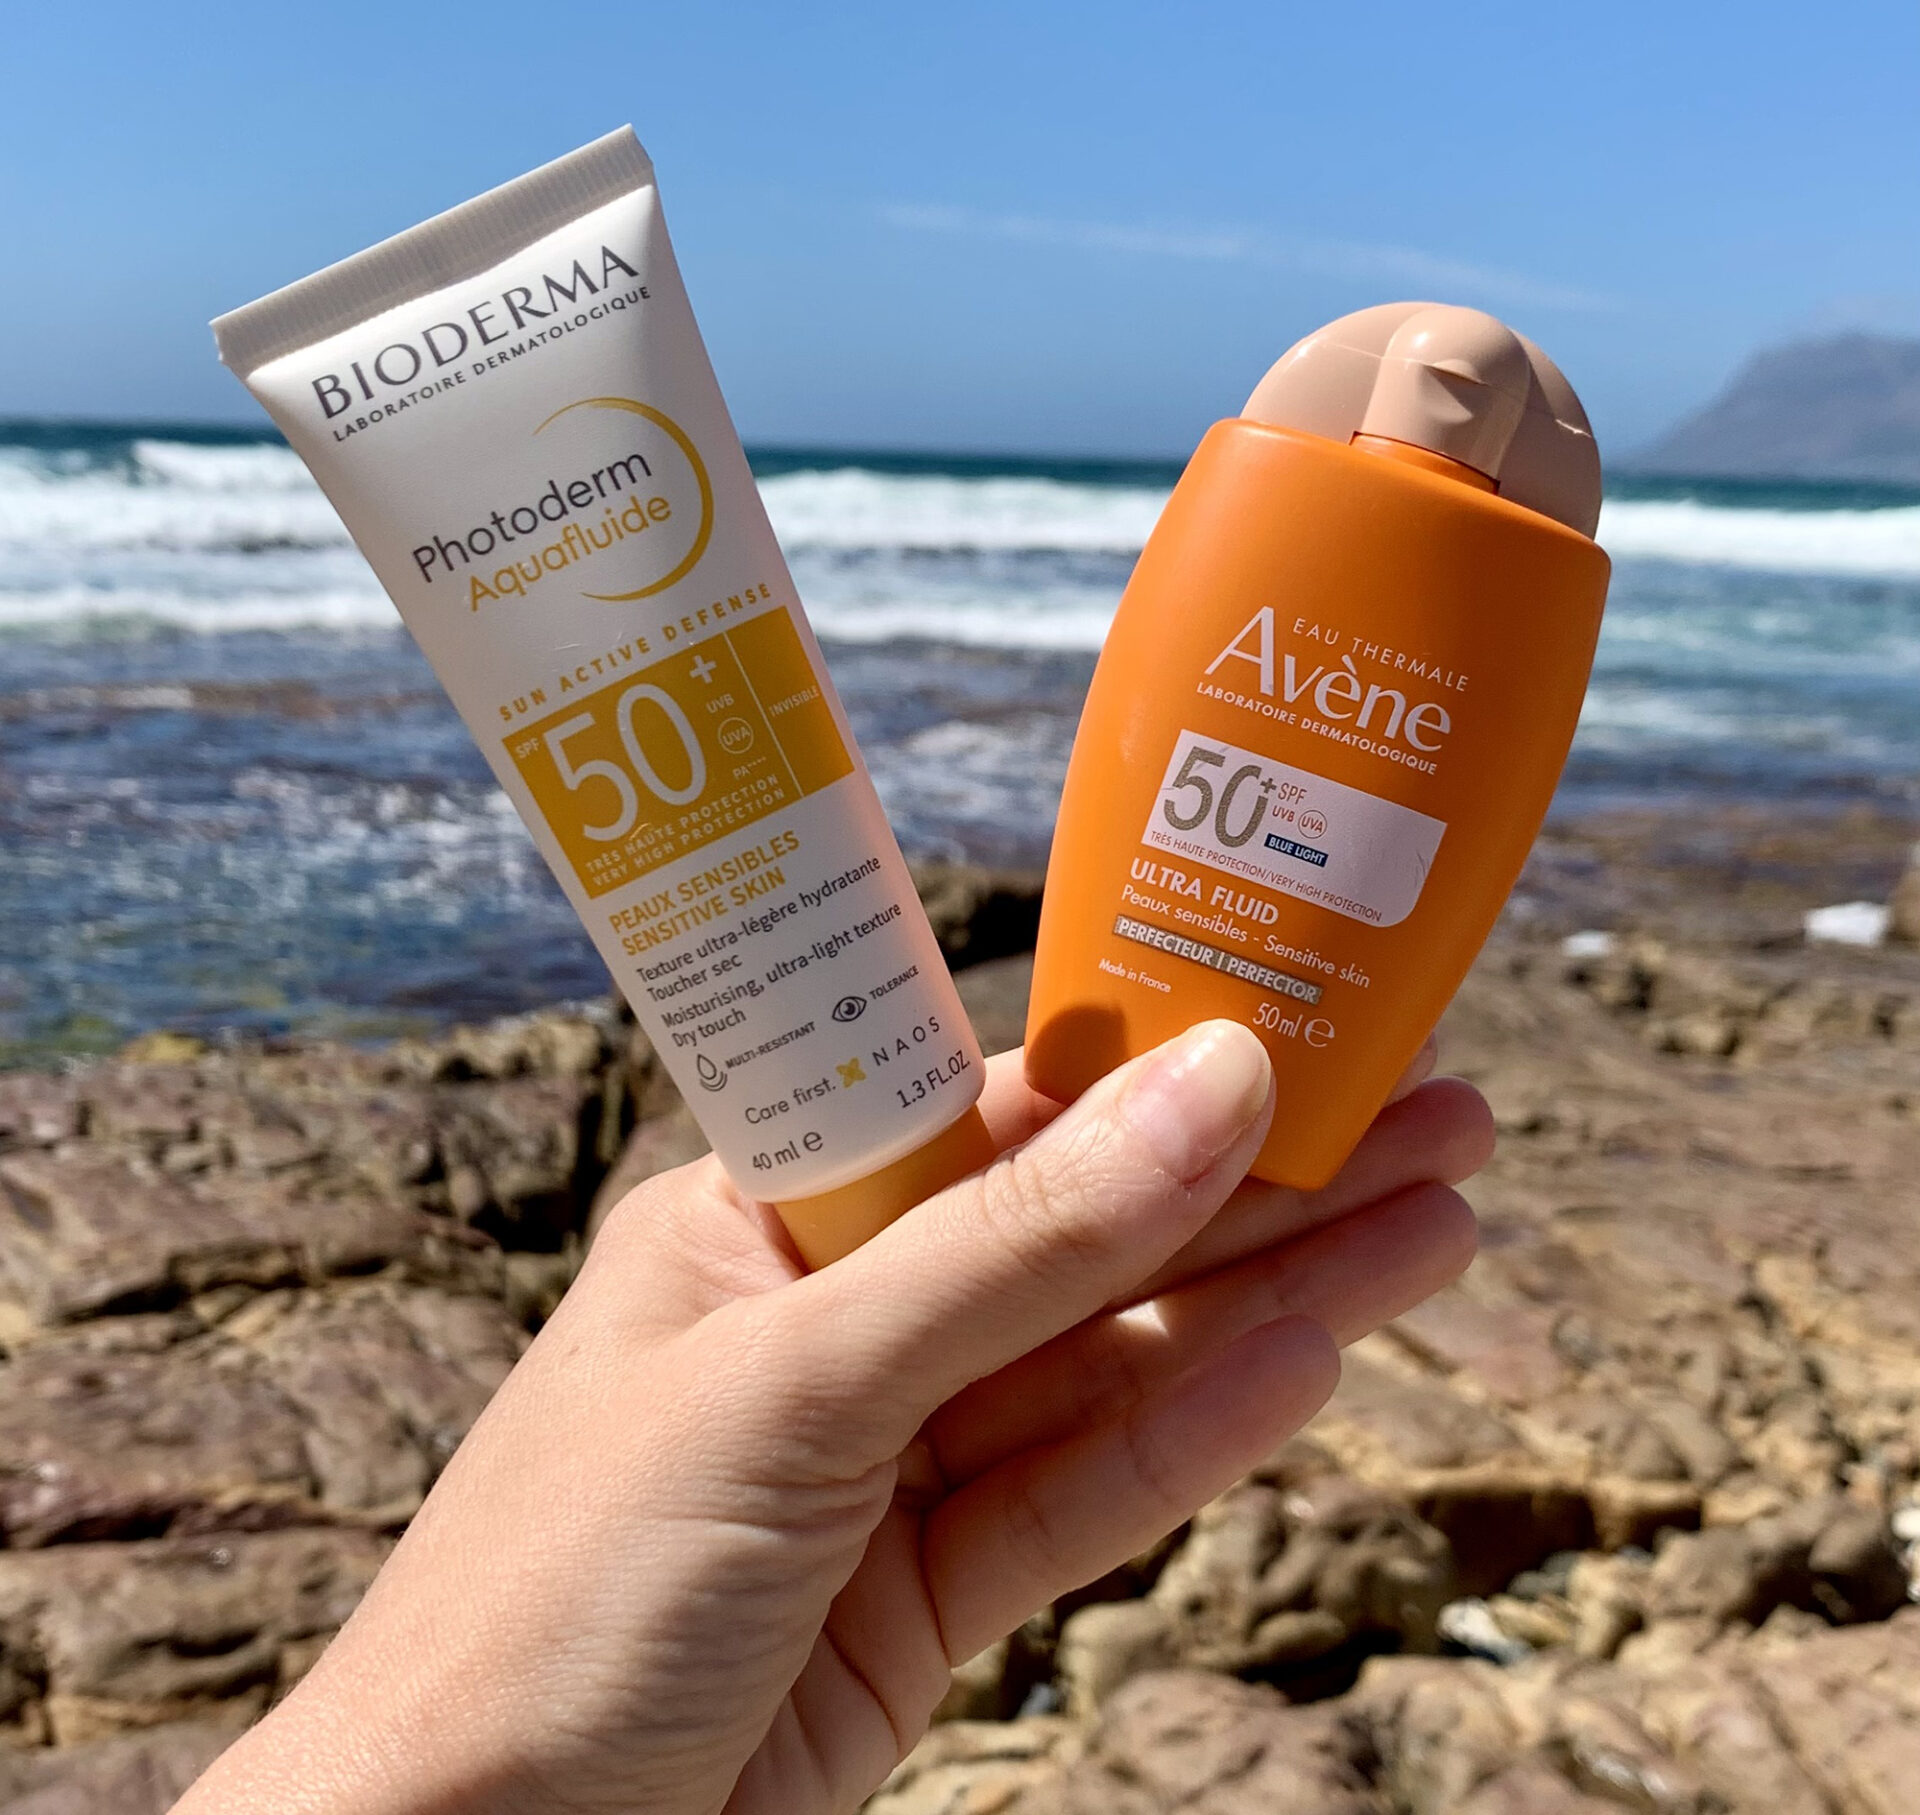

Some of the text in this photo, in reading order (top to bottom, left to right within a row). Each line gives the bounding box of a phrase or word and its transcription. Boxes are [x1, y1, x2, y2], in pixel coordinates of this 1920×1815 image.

[311, 245, 640, 419] BIODERMA
[333, 286, 651, 442] LABORATOIRE DERMATOLOGIQUE
[413, 453, 652, 583] Photoderm
[467, 496, 672, 612] Aquafluide
[499, 583, 771, 721] SUN ACTIVE DEFENSE
[1203, 605, 1451, 752] Avène
[1292, 617, 1469, 692] EAU THERMALE
[706, 694, 734, 714] UVB
[722, 725, 751, 748] UVA
[769, 685, 820, 718] INVISIBLE
[1196, 681, 1438, 776] LABORATOIRE DERMATOLOGIQUE
[515, 737, 540, 760] SPF
[586, 774, 779, 874] TRÈS HAUTE PROTECTION
[1272, 806, 1324, 834] UVB UVA
[1277, 783, 1307, 805] SPF
[592, 788, 786, 887] VERY HIGH PROTECTION
[1268, 836, 1325, 865] BLUE LIGHT
[609, 830, 800, 935] PEAUX SENSIBLES
[621, 866, 787, 956] SENSITIVE SKIN
[1130, 857, 1279, 926] ULTRA FLUID
[1173, 840, 1206, 859] HAUTE
[1295, 882, 1322, 900] HIGH
[1322, 890, 1382, 923] PROTECTION
[636, 856, 882, 983] Texture ultra-légère hydratante
[1121, 883, 1170, 916] Peaux
[1173, 906, 1247, 943] sensibles
[1263, 934, 1336, 976] Sensitive
[1338, 963, 1371, 989] skin
[647, 953, 743, 1004] Toucher sec
[661, 902, 902, 1028] Moisturising, ultra-light texture
[869, 965, 920, 1000] TOLERANCE
[1099, 958, 1172, 993] Made in France
[1117, 918, 1213, 967] PERFECTEUR
[1226, 956, 1318, 1004] PERFECTOR
[671, 1008, 747, 1048] Dry touch
[725, 1021, 816, 1069] MULTI-RESISTANT
[744, 1076, 836, 1125] Care first.
[896, 1079, 927, 1109] 1.3
[751, 1150, 772, 1171] 40
[775, 1140, 801, 1166] ml
